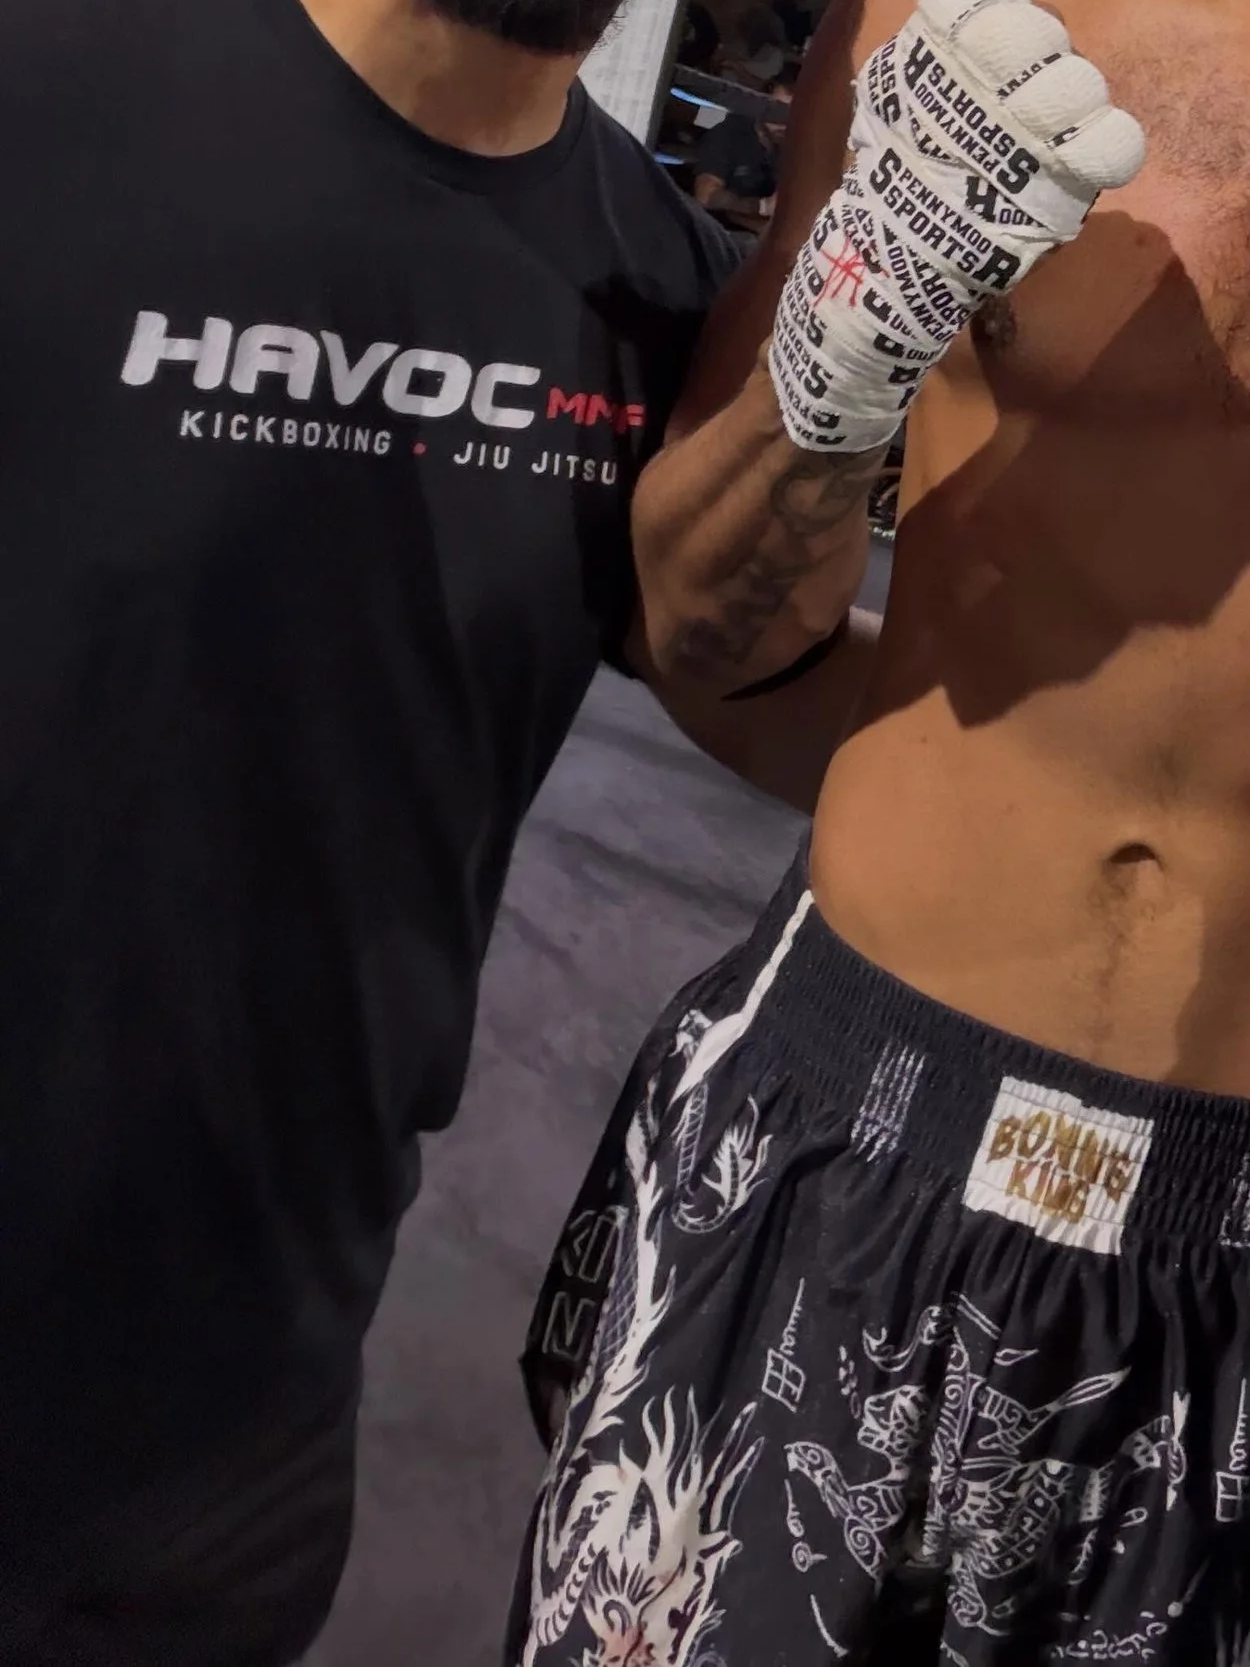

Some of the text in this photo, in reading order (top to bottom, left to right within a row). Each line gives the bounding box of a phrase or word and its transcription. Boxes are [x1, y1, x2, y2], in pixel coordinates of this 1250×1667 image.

[884, 185, 979, 273] SPORTS
[120, 310, 541, 429] HAVOC
[180, 410, 617, 485] KICKBOXING JIU JITSU
